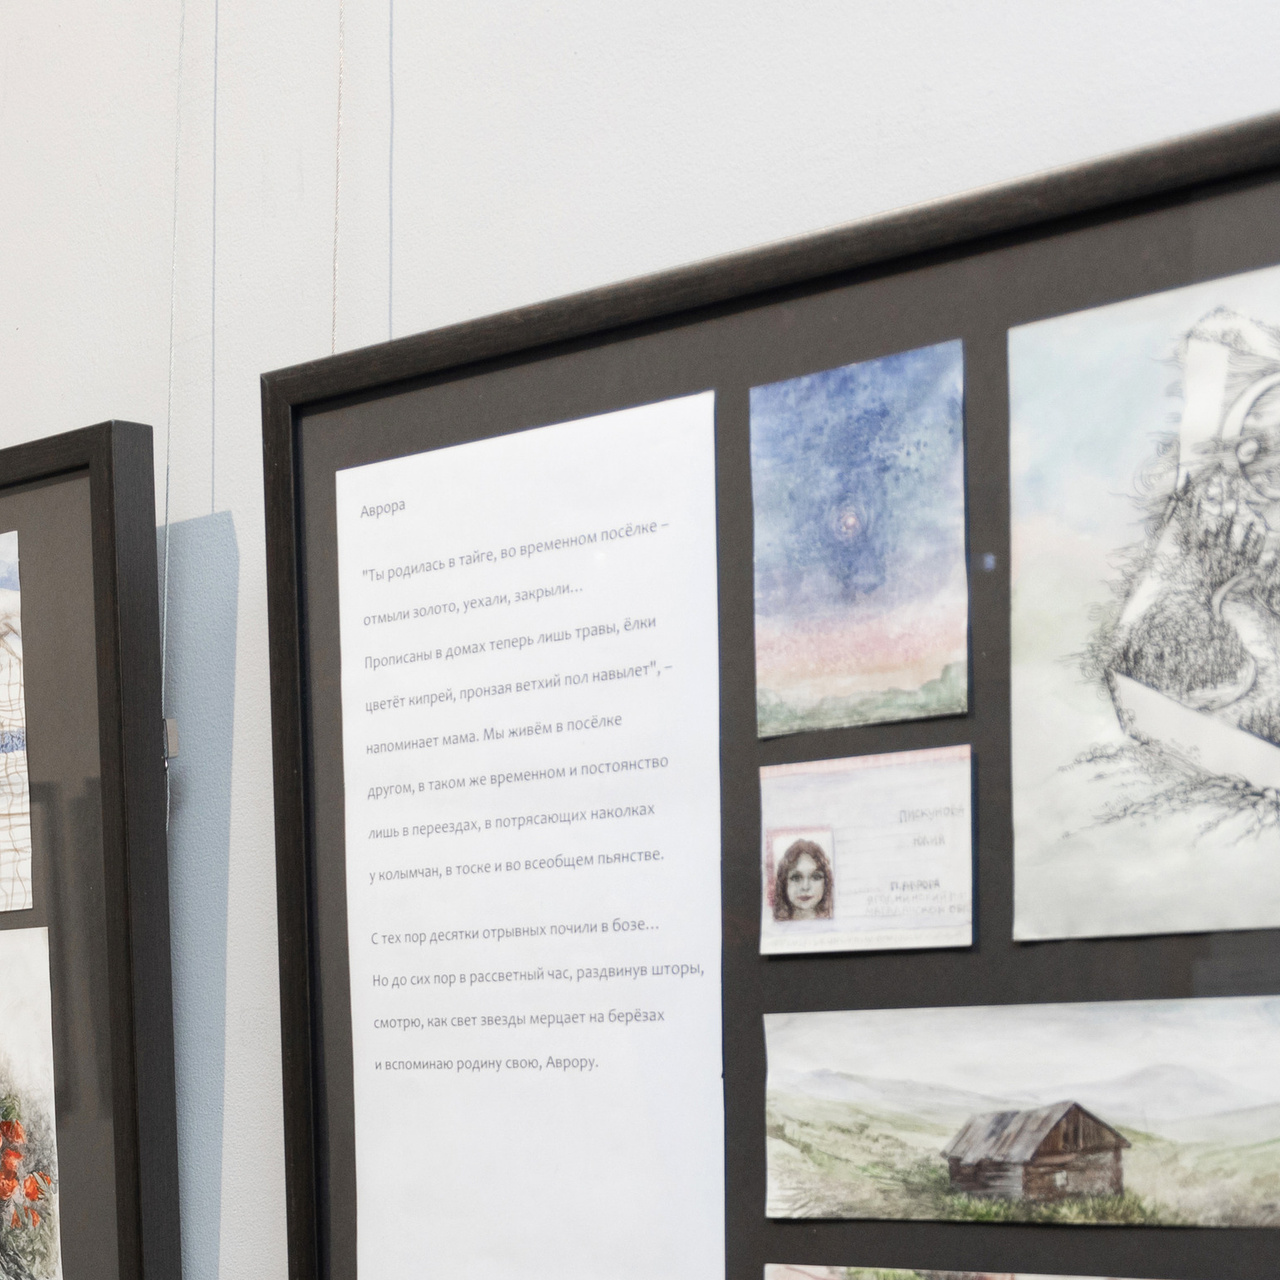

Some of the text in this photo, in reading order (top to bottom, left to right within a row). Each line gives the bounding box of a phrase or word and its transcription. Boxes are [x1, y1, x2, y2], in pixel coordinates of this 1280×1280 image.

[360, 500, 405, 518] Аврора
[387, 560, 445, 582] родилась
[448, 557, 455, 567] в
[458, 549, 496, 565] тайге,
[500, 546, 516, 558] во
[519, 532, 596, 558] временном
[601, 521, 656, 540] посёлке
[363, 610, 409, 625] отмыли
[413, 602, 459, 618] золото,
[463, 594, 510, 613] уехали,
[365, 617, 655, 670] Прописаны в домах теперь лишь травы, ёлки
[365, 695, 405, 714] цветёт
[409, 688, 455, 706] кипрей,
[460, 683, 511, 702] пронзая
[515, 673, 560, 692] ветхий
[564, 673, 588, 685] пол
[366, 715, 621, 754] напоминает мама. Мы живём в посёлке
[367, 756, 668, 799] другом, в таком же временном и постоянство
[368, 804, 654, 838] лишь в переездах, в потрясающих наколках
[369, 850, 663, 885] у колымчан, в тоске и во всеобщем пьянстве.
[371, 932, 378, 944] С
[381, 934, 401, 943] тех
[404, 932, 426, 945] пор
[429, 930, 478, 944] десятки
[482, 926, 546, 941] отрывных
[550, 923, 597, 934] почили
[601, 922, 608, 932] в
[373, 964, 703, 988] Но до сих пор в рассветный час, раздвинув шторы,
[373, 1008, 664, 1031] смотрю, как свет звезды мерцает на берёзах
[375, 1056, 598, 1072] и вспоминаю родину свою, Аврору.
